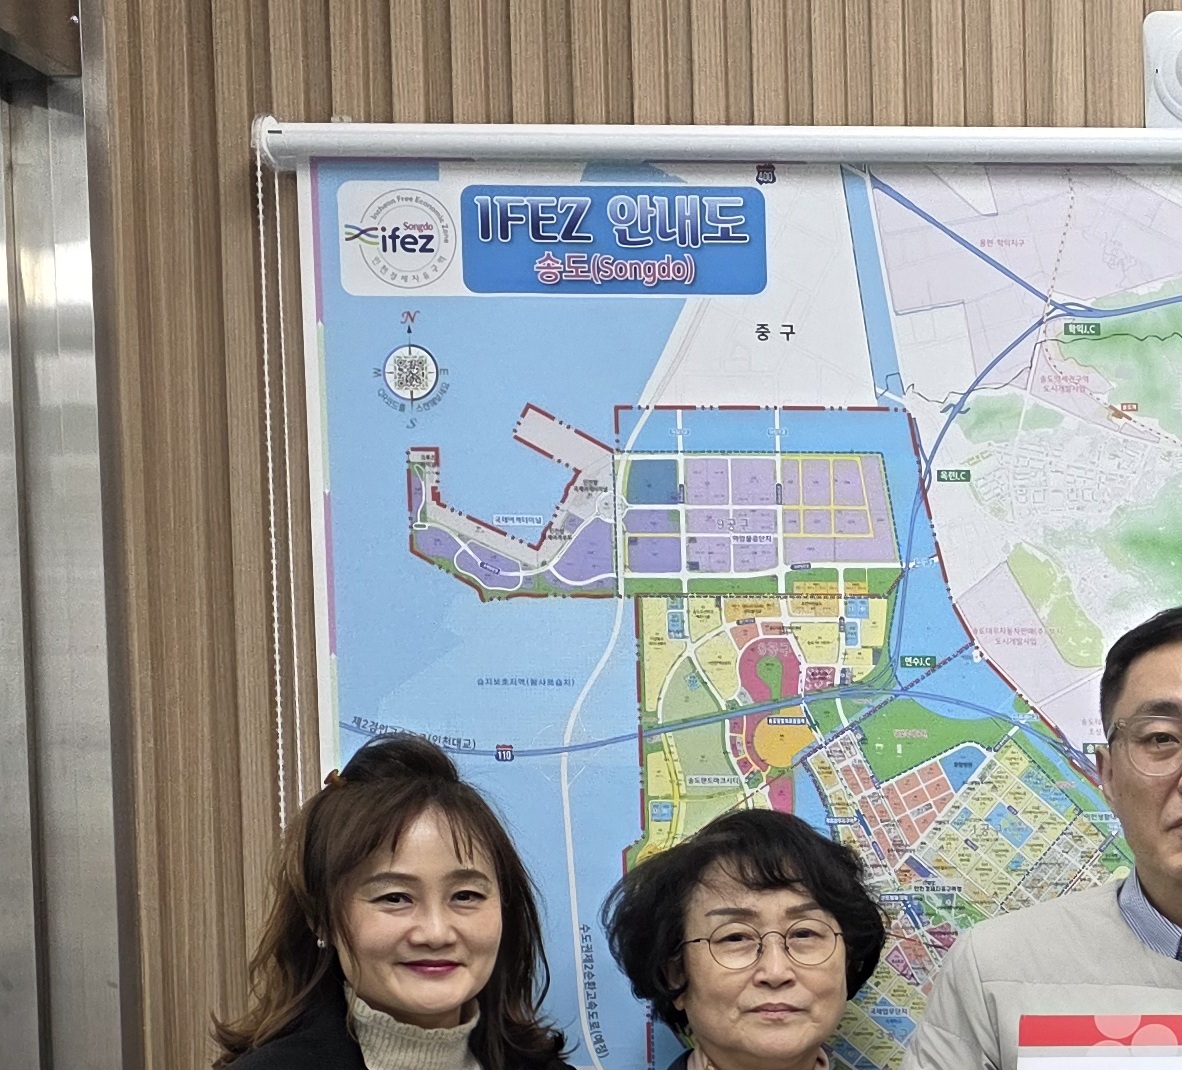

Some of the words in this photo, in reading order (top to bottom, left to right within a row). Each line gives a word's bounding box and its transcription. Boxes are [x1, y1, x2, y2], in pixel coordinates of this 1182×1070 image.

[403, 221, 434, 233] Songdo
[474, 196, 593, 243] IFEZ
[607, 194, 750, 249] 안내도
[381, 226, 435, 253] ifez
[534, 251, 696, 286] 송도(Songdo)
[400, 310, 420, 324] N
[497, 750, 512, 760] 110
